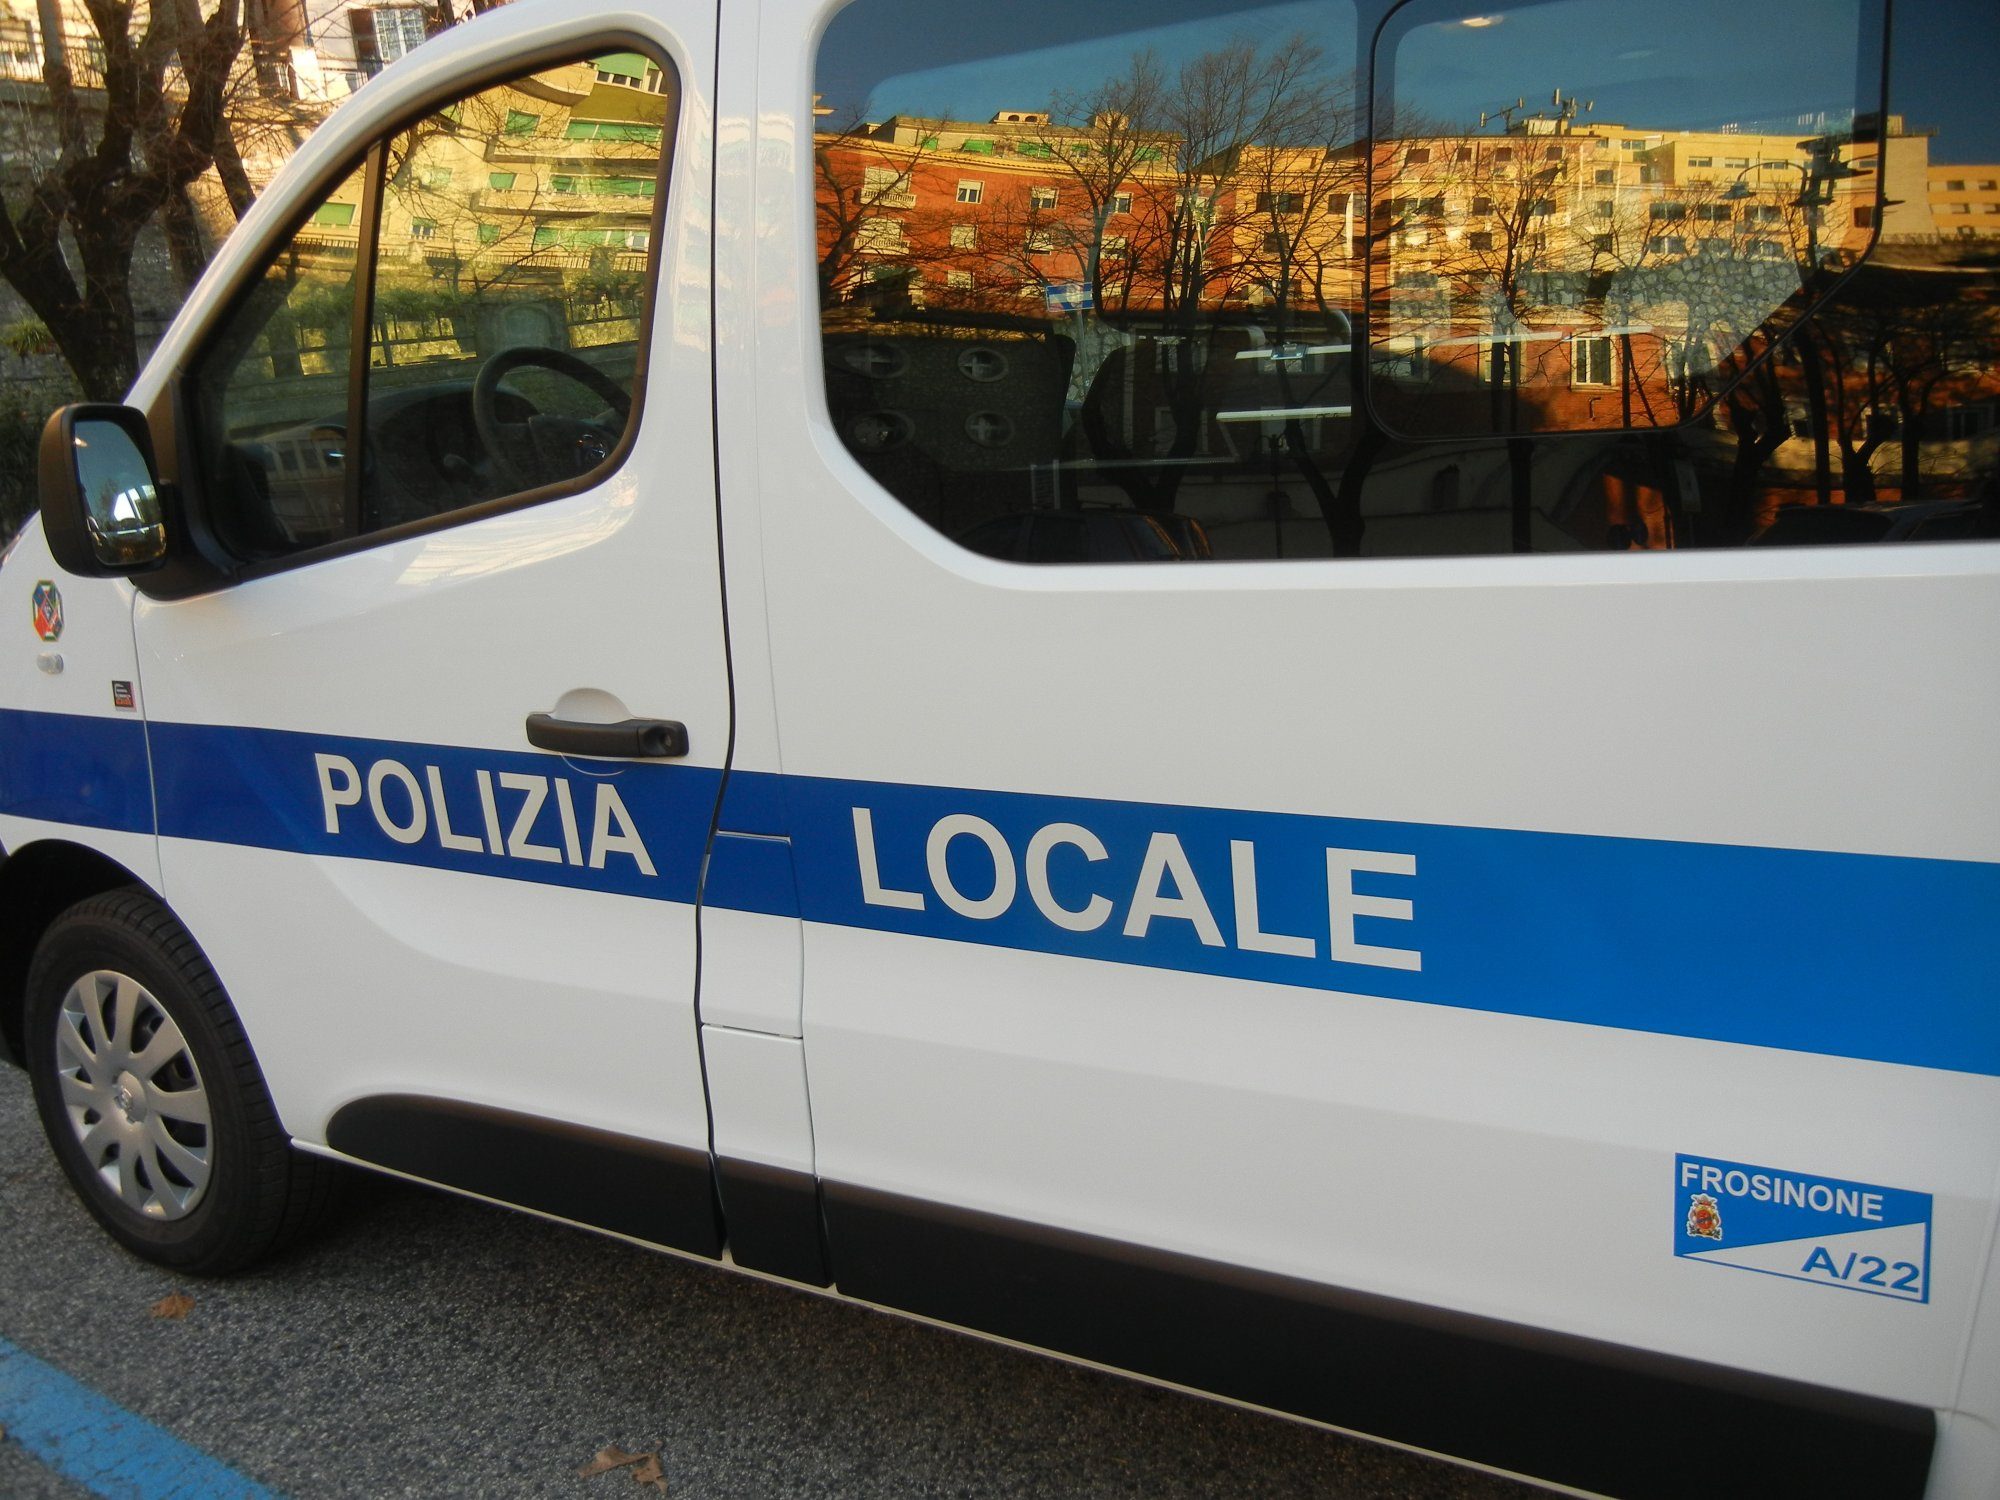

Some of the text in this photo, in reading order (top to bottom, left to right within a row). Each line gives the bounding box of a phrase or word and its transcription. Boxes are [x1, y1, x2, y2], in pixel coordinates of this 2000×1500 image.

[314, 752, 1422, 972] POLIZIA LOCALE
[1681, 1162, 1883, 1221] FROSINONE
[1801, 1246, 1920, 1293] A/22
